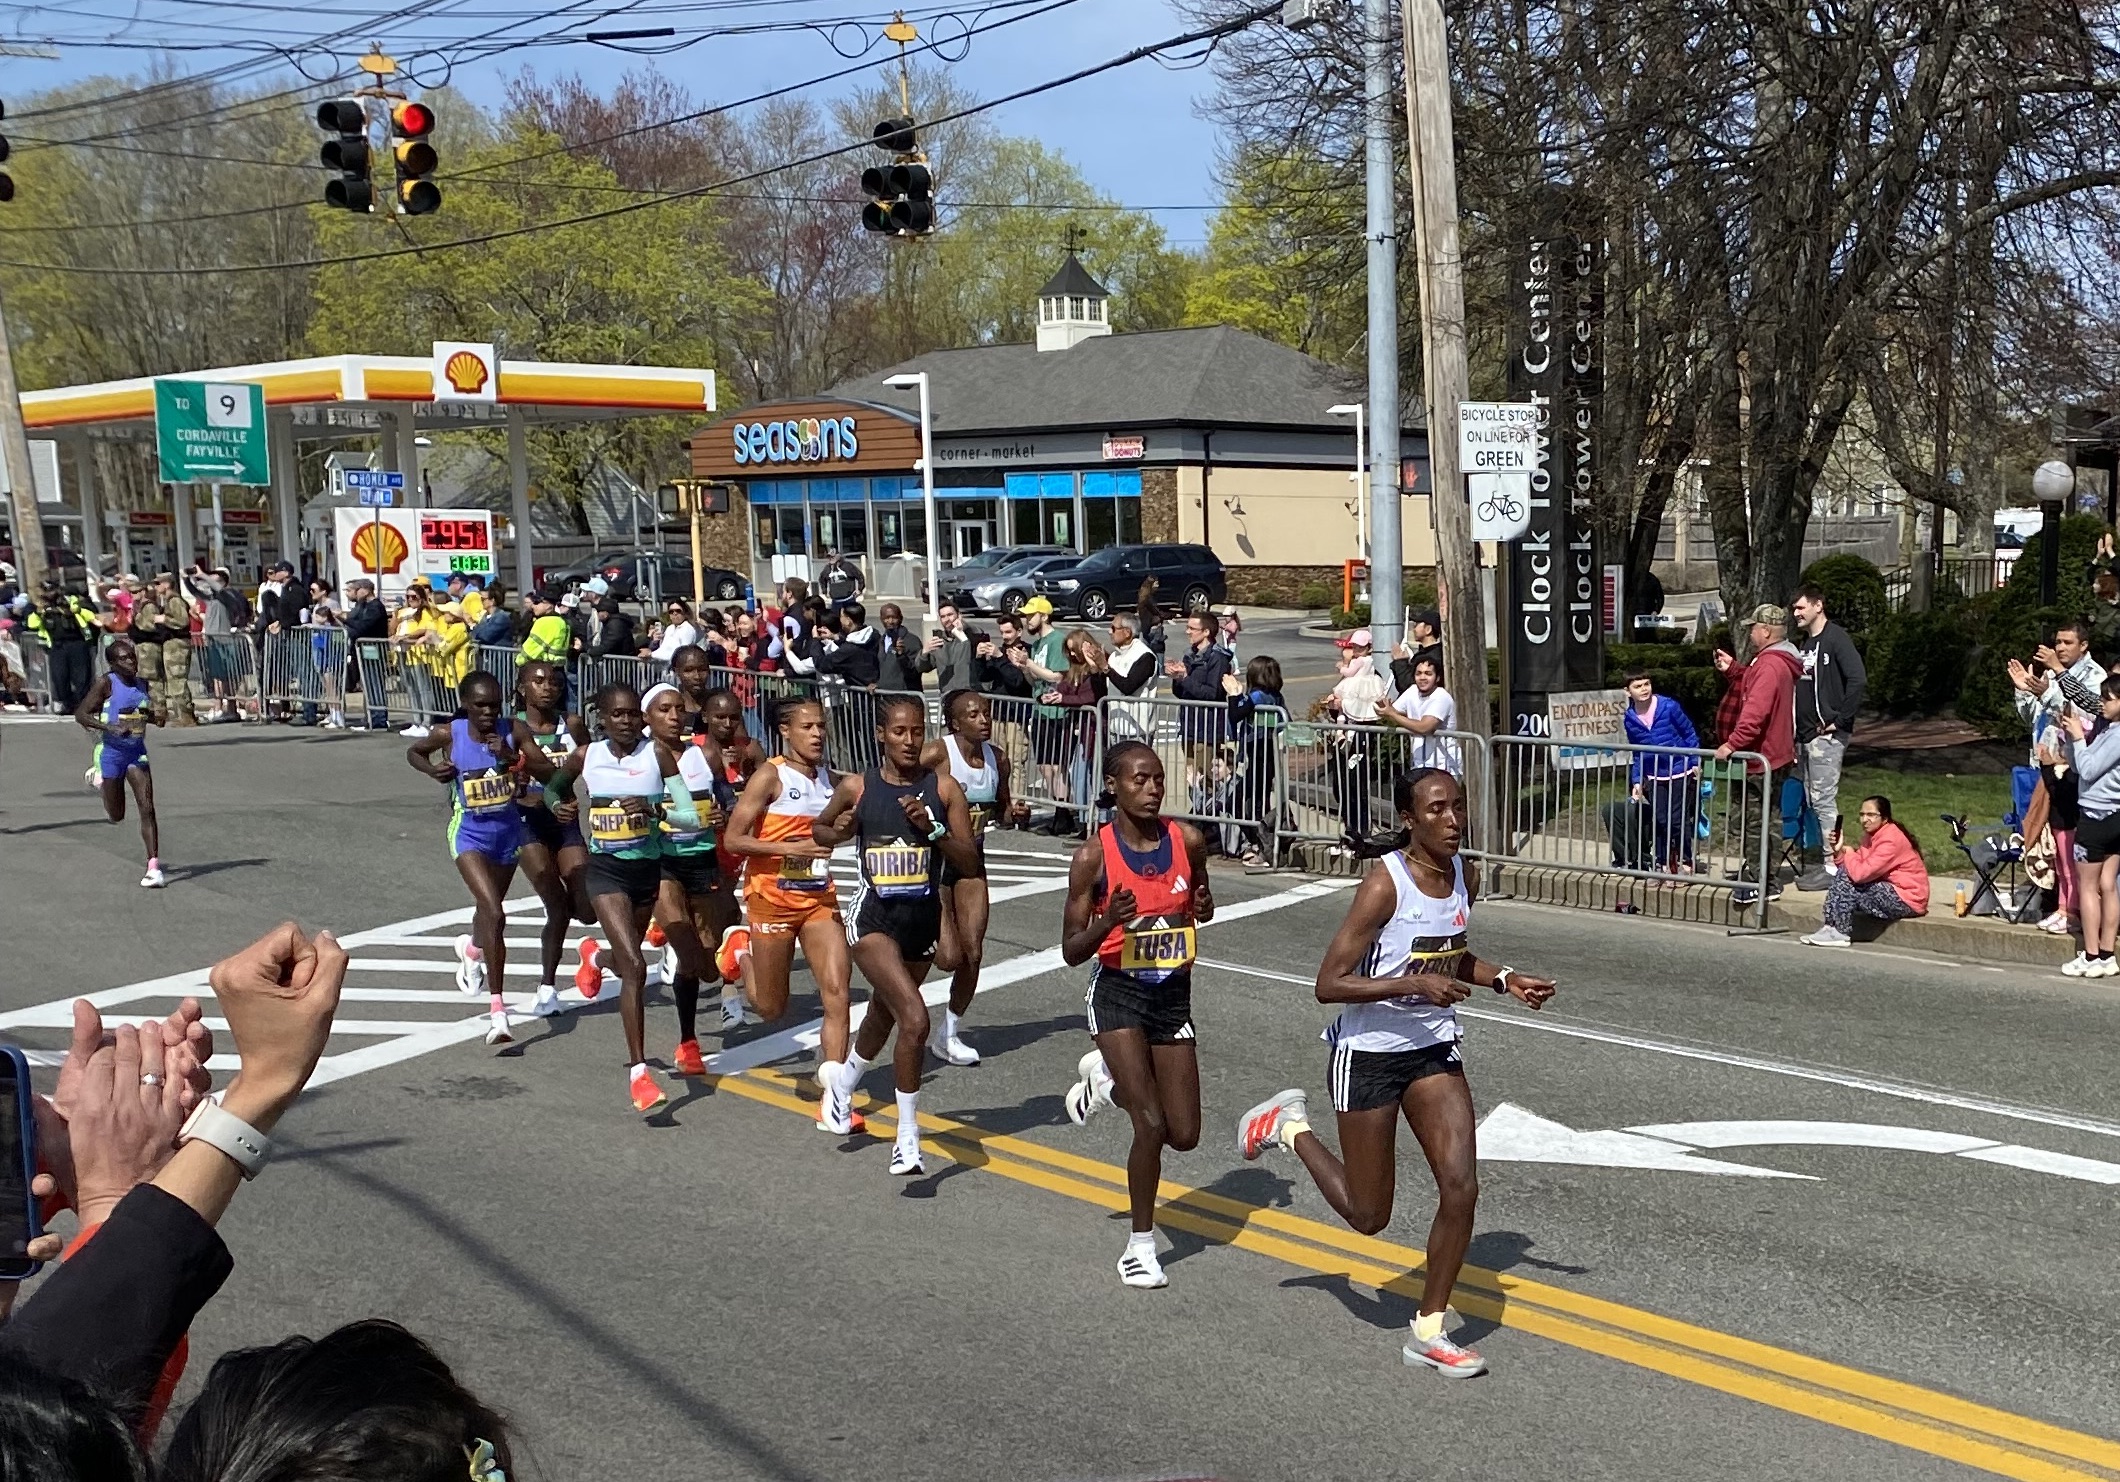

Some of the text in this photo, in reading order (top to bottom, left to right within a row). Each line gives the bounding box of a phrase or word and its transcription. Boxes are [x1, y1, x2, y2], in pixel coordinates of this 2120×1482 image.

[175, 395, 235, 416] TO 9
[1461, 409, 1535, 421] BICYCLE STOP
[176, 429, 248, 443] CORDAVILLE
[733, 416, 858, 463] seasons
[1467, 431, 1530, 443] ON LINE FOR
[1570, 240, 1592, 644] Clock Tower Cener
[186, 444, 241, 458] FAYVILLE
[940, 443, 1035, 460] corner market
[1475, 450, 1524, 467] GREEN
[422, 521, 474, 548] 2.95
[1521, 529, 1551, 644] Clock
[1552, 702, 1626, 720] ENCOMPASS
[1565, 721, 1619, 737] FITNESS
[866, 850, 929, 877] DIRIBA
[1132, 931, 1188, 961] TUSA
